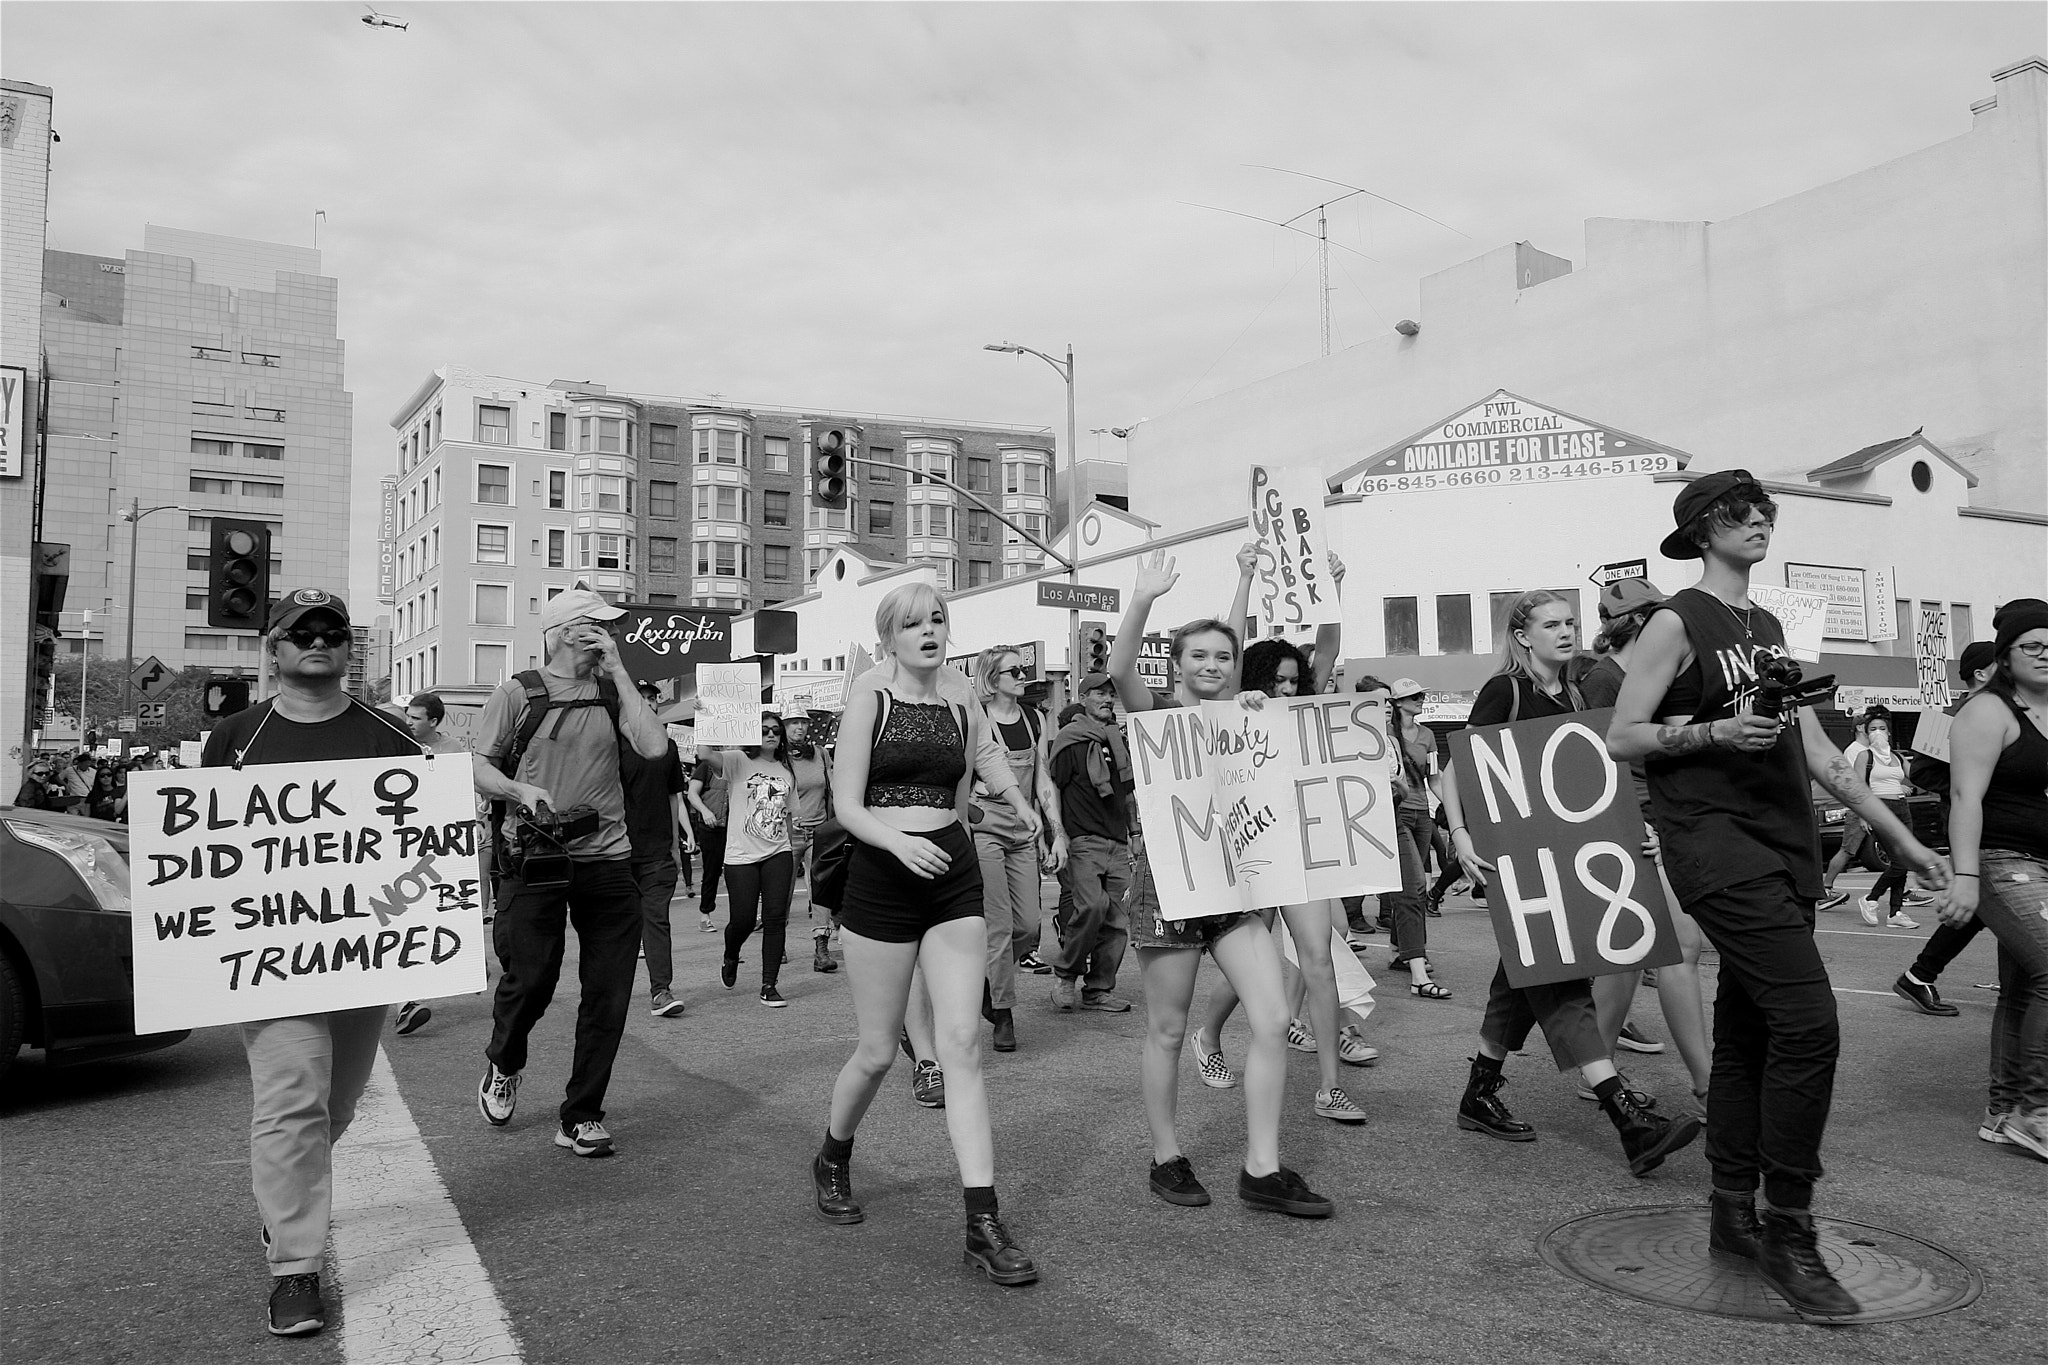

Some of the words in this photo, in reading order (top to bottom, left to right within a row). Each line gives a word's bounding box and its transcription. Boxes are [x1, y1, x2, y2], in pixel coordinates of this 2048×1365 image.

[1443, 416, 1562, 438] COMMERCIAL
[1484, 401, 1520, 418] FWL
[1404, 439, 1501, 473] AVAILABLE
[1506, 436, 1542, 464] FOR
[1548, 431, 1606, 461] LEASE
[1509, 456, 1669, 482] 213-446-5129
[384, 492, 393, 539] GEORGE
[1252, 466, 1280, 624] PUSSY
[1265, 488, 1304, 624] GRABS
[1292, 507, 1323, 606] BACK
[381, 543, 393, 596] HOTEL
[1605, 570, 1621, 580] ONE
[1624, 567, 1641, 577] WAY
[1042, 586, 1063, 600] Los
[1067, 588, 1115, 607] Angeles
[1875, 572, 1888, 633] IMMIGRATION
[625, 615, 724, 655] Lexington
[1921, 610, 1946, 635] MAKE
[702, 665, 743, 683] FUCK
[1919, 656, 1947, 682] AFRAID
[140, 704, 164, 718] 25
[701, 683, 754, 700] ORRUPT
[1920, 681, 1949, 706] AGAIN
[446, 711, 477, 727] NOT
[721, 719, 759, 740] TRUMP
[1133, 700, 1386, 785] MINTIES
[1205, 716, 1280, 768] Nasty
[1218, 767, 1257, 786] WOMEN
[1470, 722, 1618, 823] NO
[157, 779, 347, 837] BLACK
[1224, 796, 1251, 844] FIGHT
[148, 844, 244, 886] DID
[252, 827, 383, 875] THEIR
[393, 820, 476, 859] PART
[155, 906, 216, 941] WE
[231, 883, 371, 931] SHALL
[369, 854, 442, 927] NOT
[429, 879, 479, 911] BE
[1497, 841, 1656, 967] H8
[219, 926, 462, 991] TRUMPED
